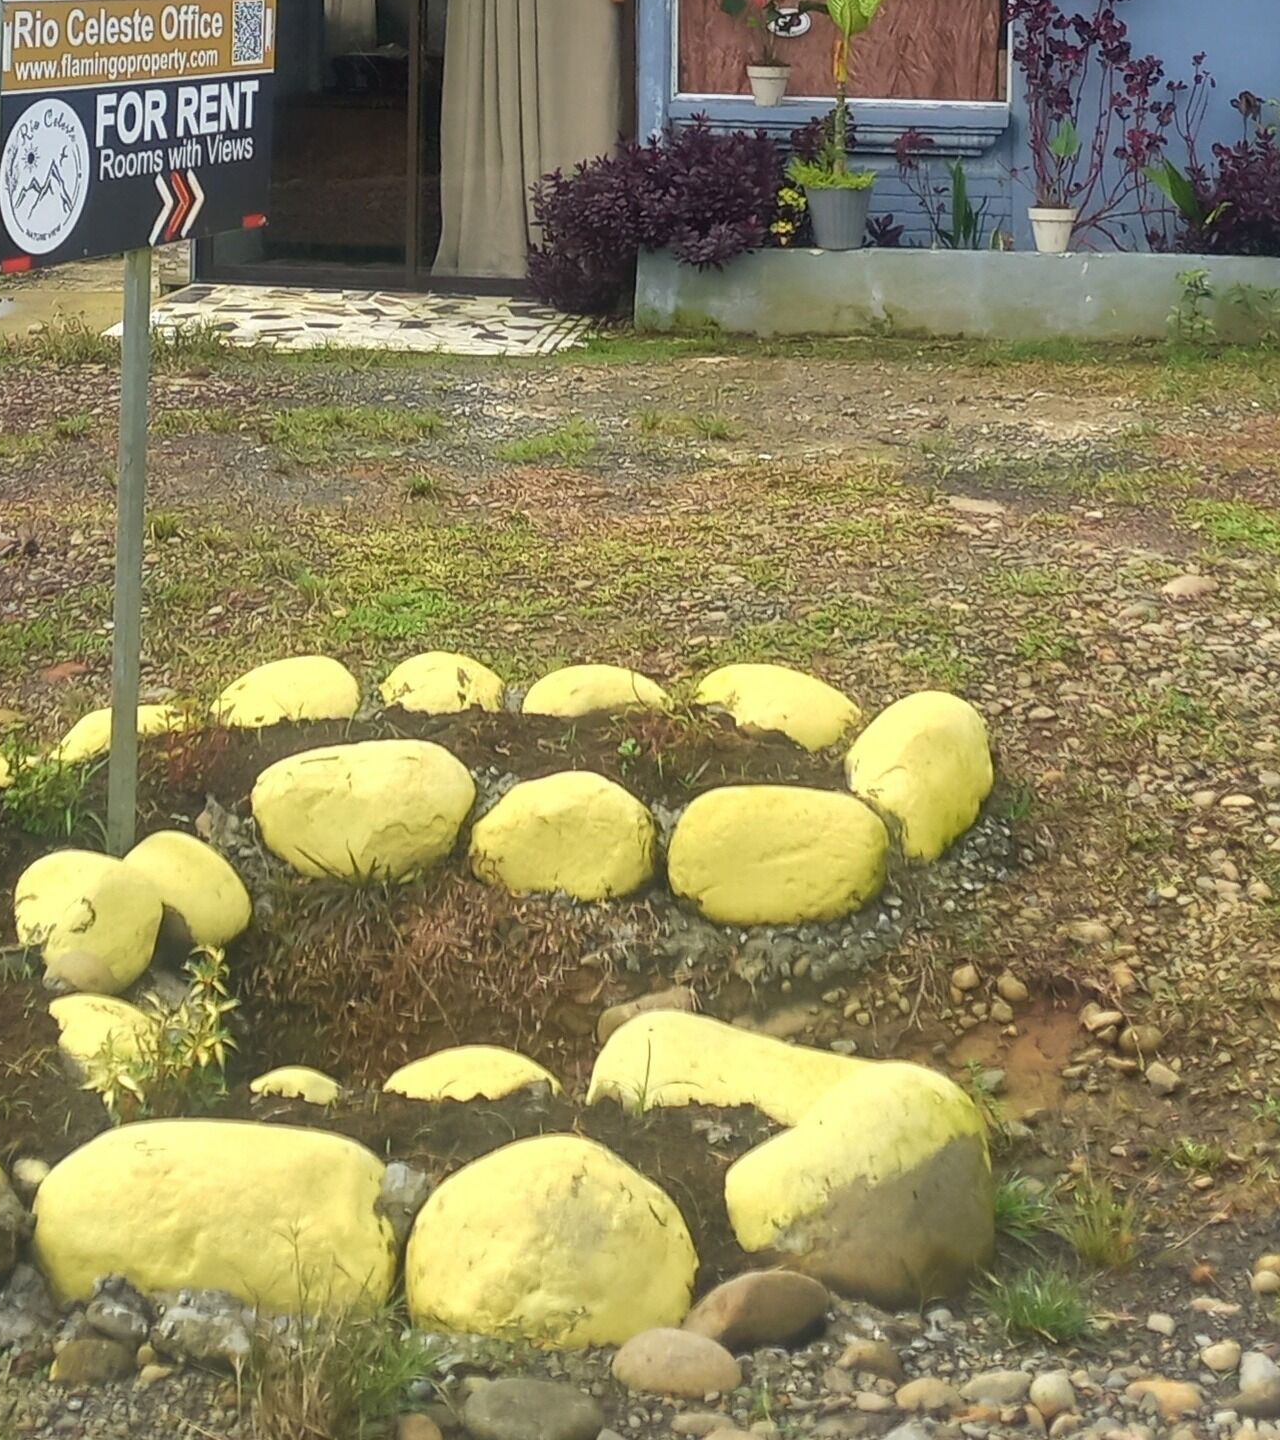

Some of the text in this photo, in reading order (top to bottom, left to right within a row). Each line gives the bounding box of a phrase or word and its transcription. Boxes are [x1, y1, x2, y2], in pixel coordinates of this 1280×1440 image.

[14, 5, 223, 48] Rio Celeste Office
[15, 48, 218, 81] www.flamingoproperty.com
[96, 80, 259, 147] FOR RENT
[99, 136, 253, 180] Rooms with Views
